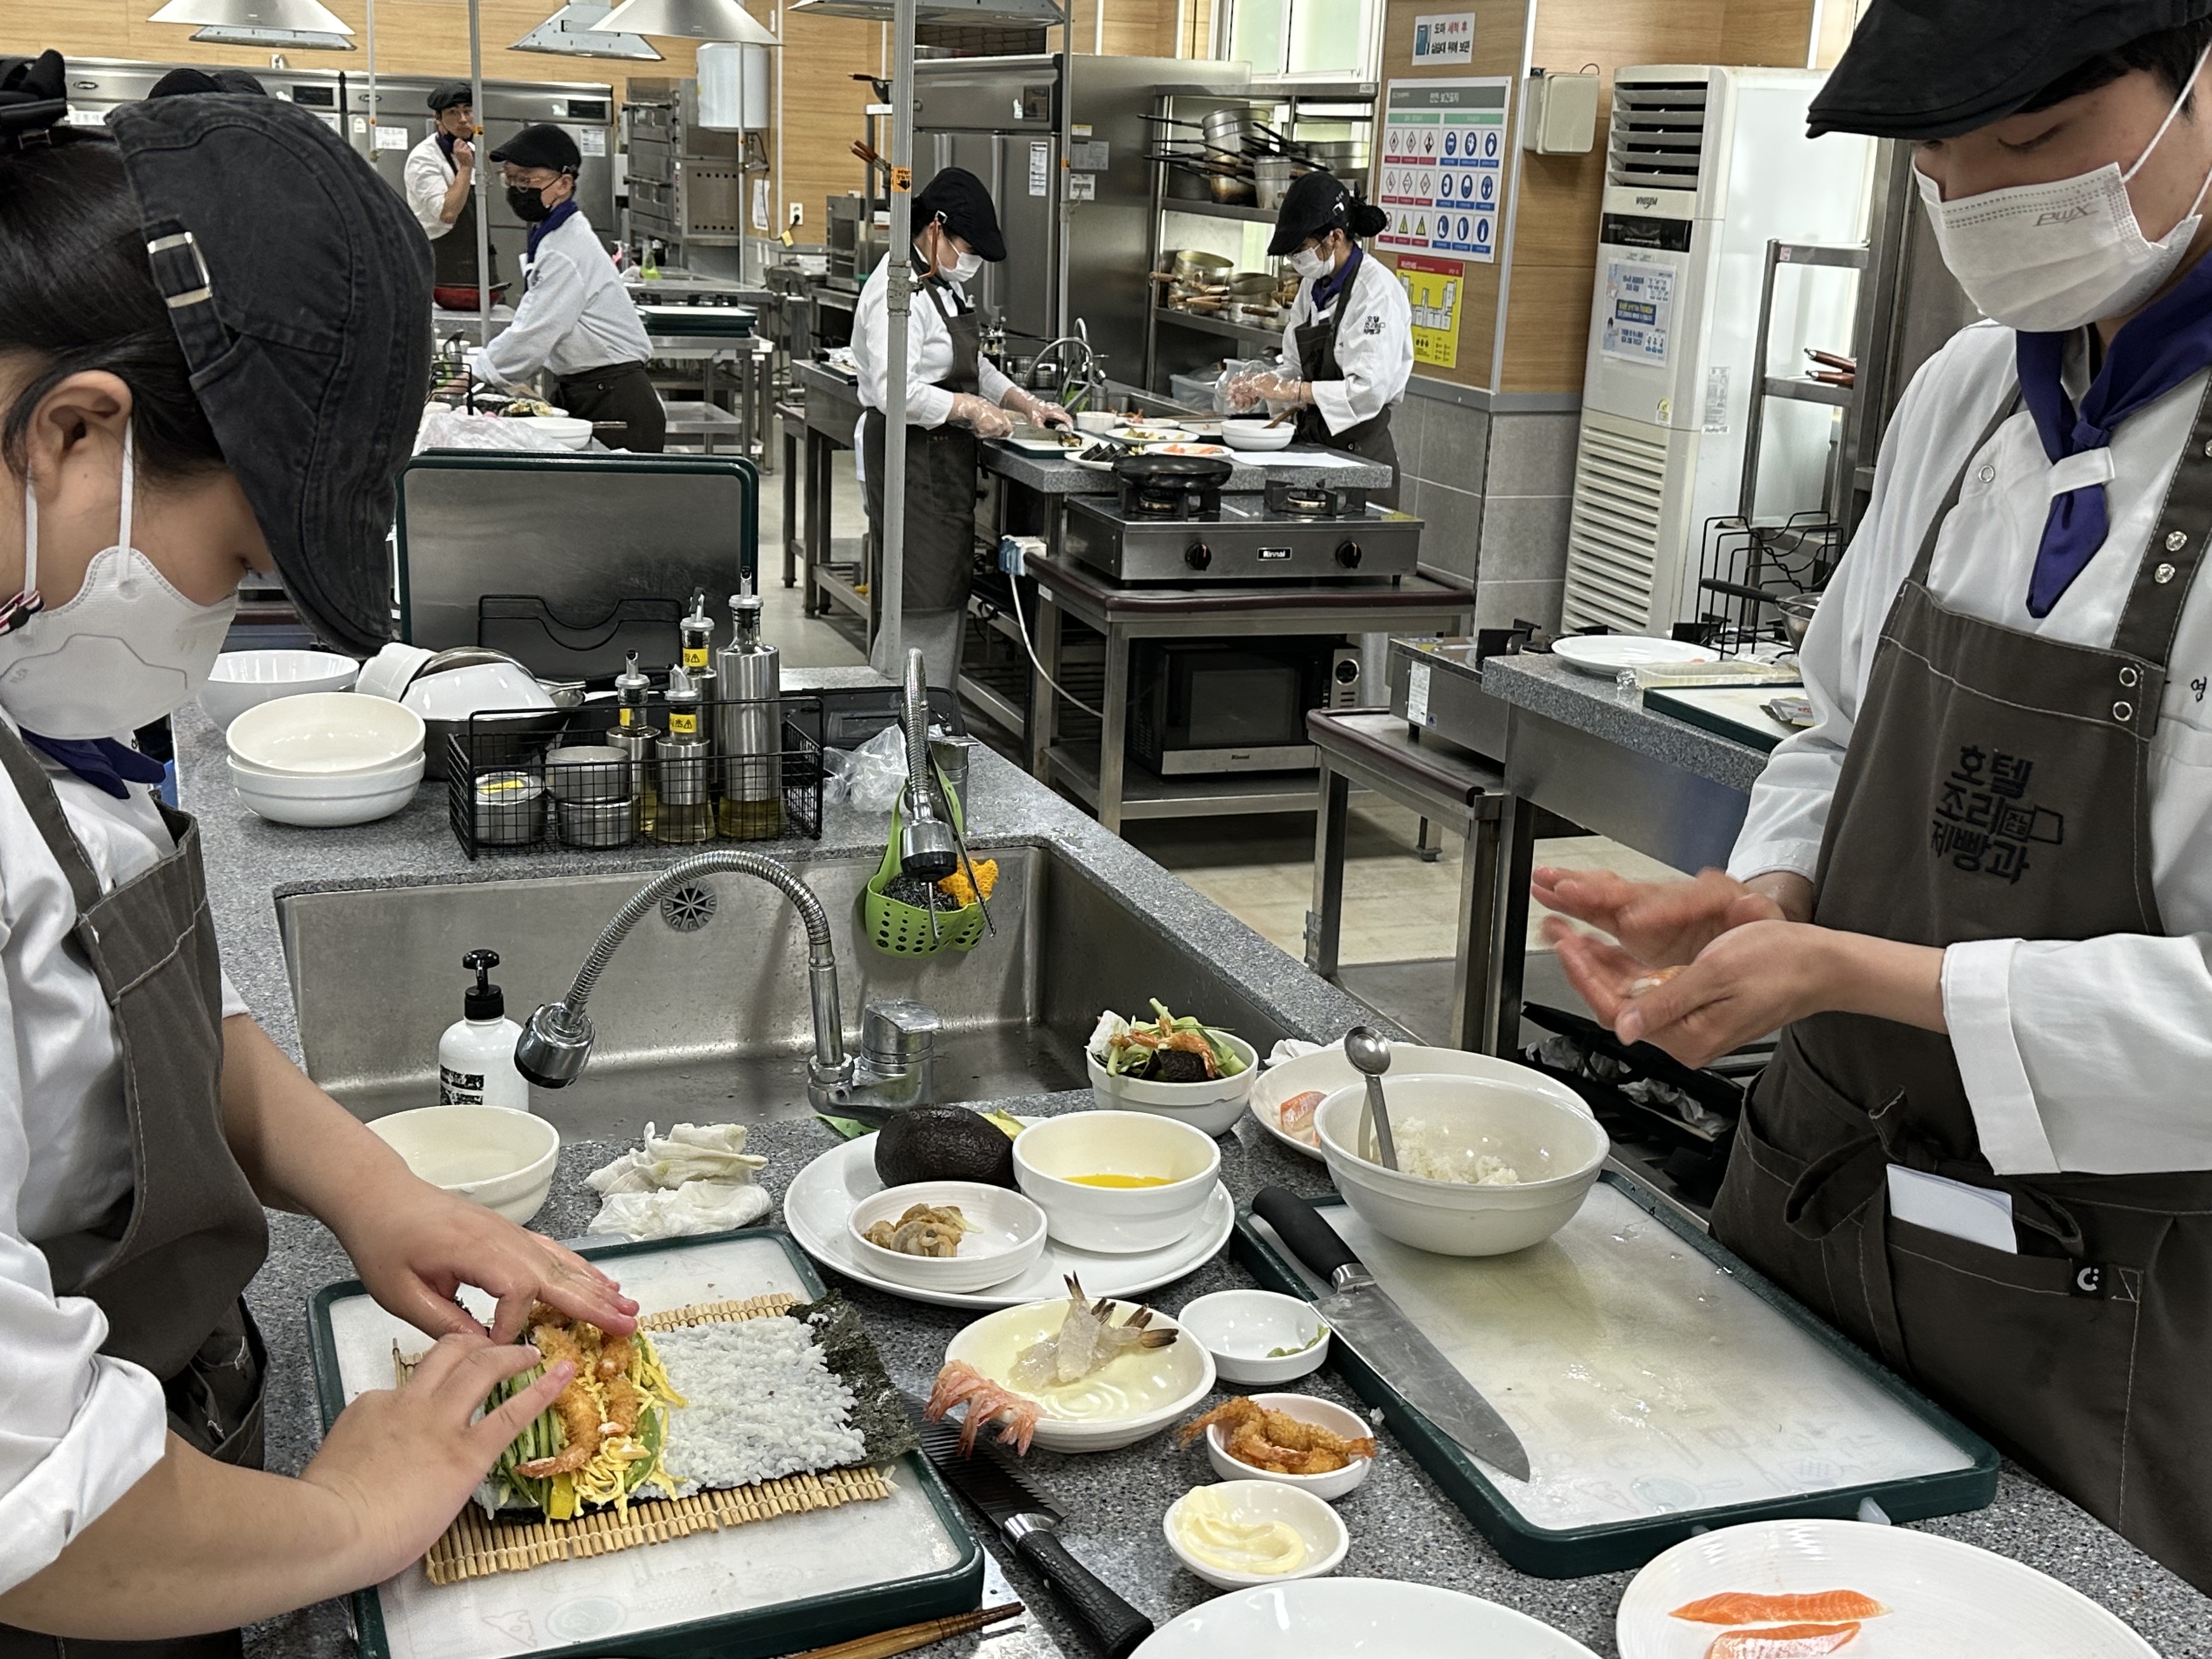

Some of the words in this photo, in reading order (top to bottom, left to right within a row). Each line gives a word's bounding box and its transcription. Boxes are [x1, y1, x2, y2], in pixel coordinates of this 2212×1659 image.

[1950, 745, 2033, 799] 호텔
[1936, 780, 2006, 834] 조리
[1931, 819, 2030, 885] 제빵과
